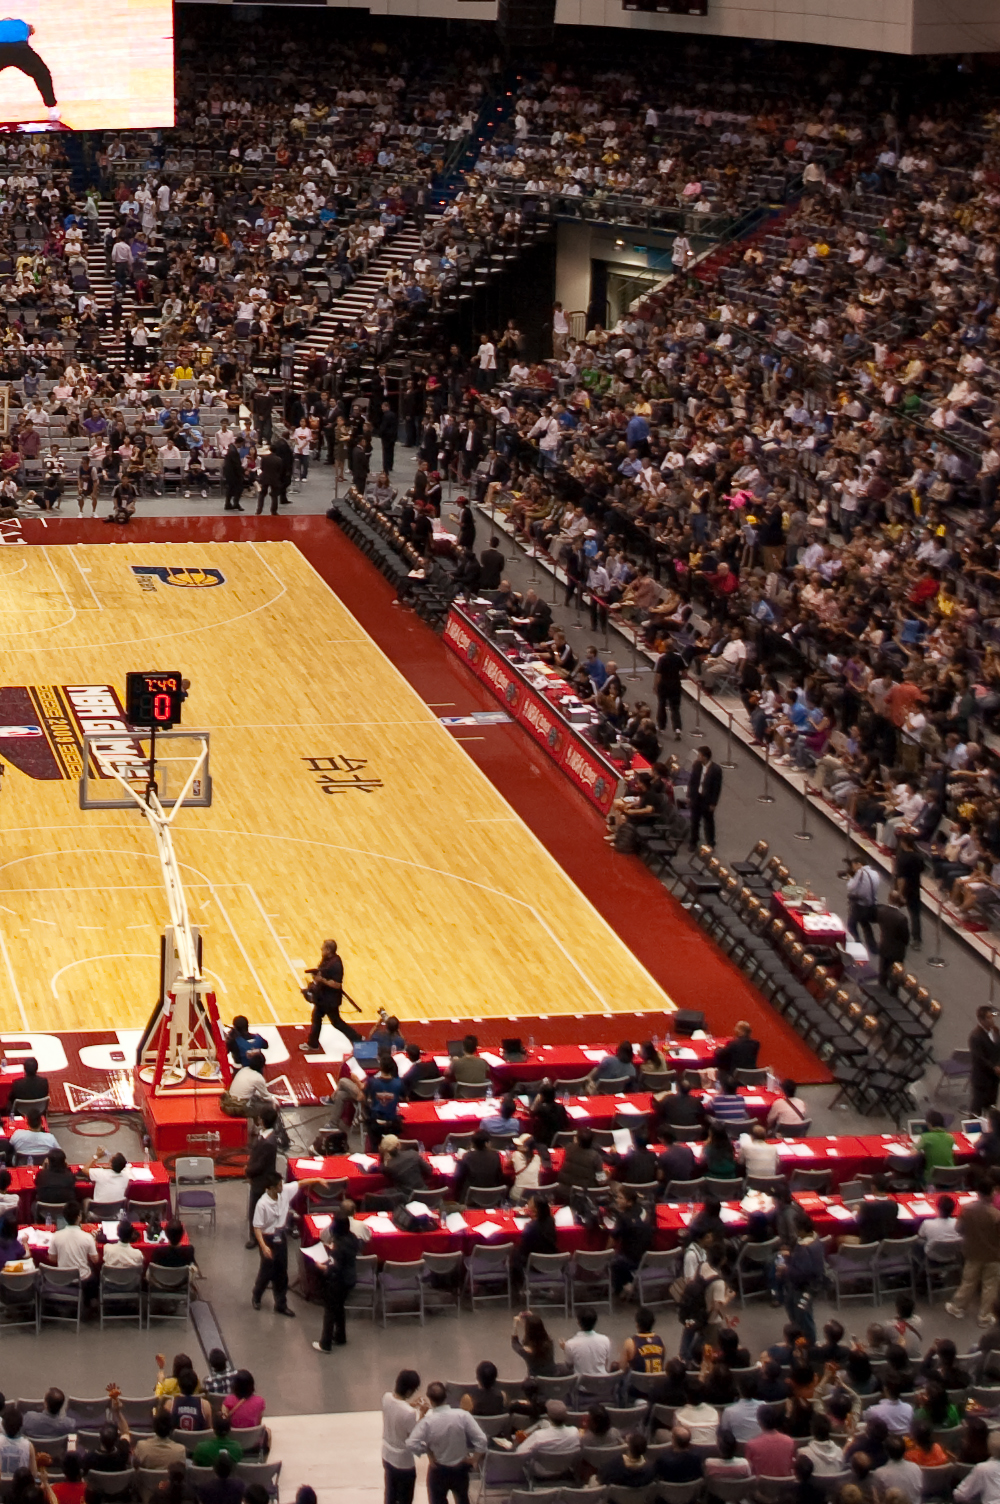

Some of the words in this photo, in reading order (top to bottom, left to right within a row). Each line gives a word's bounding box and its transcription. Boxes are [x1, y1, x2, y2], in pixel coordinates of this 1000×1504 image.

[66, 686, 121, 717] NBA
[154, 694, 170, 720] 0
[48, 718, 75, 743] 2009
[300, 754, 384, 795] 台北
